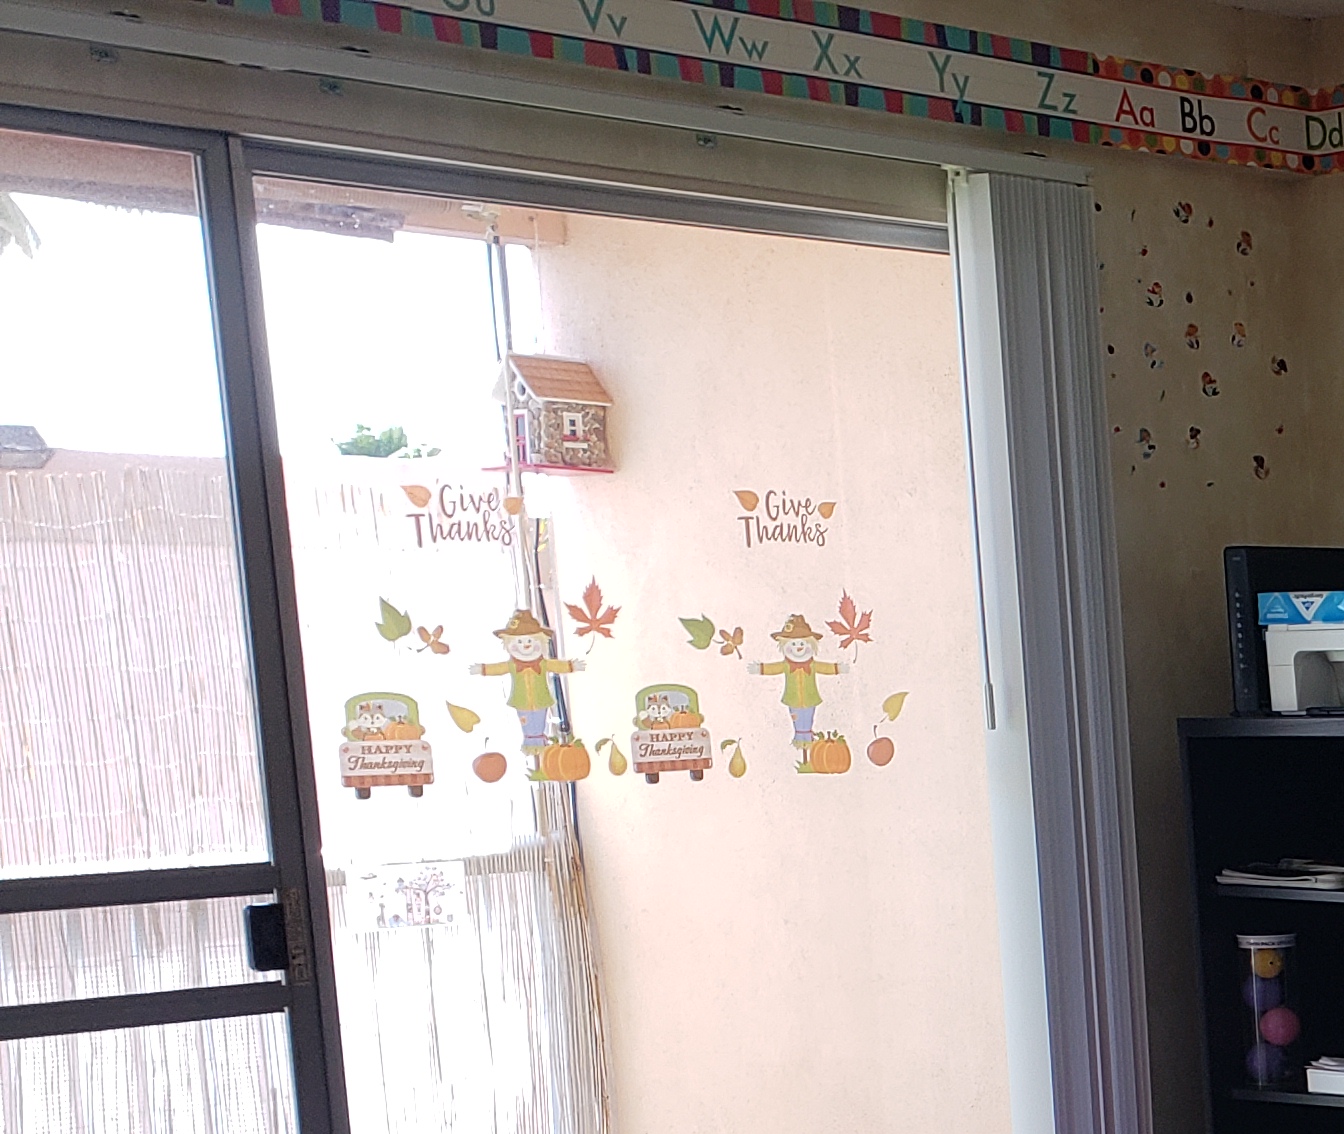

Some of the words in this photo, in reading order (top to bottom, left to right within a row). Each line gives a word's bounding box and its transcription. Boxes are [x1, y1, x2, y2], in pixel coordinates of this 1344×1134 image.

[578, 0, 627, 37] Vv
[692, 9, 768, 60] Ww
[812, 30, 873, 78] Xx
[928, 51, 969, 113] Yy
[1037, 72, 1077, 114] Zz
[1115, 88, 1155, 127] Aa
[1180, 96, 1216, 137] Bb
[1247, 107, 1280, 145] Cc
[1306, 112, 1344, 150] Dd
[434, 483, 500, 519] Give
[764, 489, 816, 521] Give
[406, 513, 515, 548] Thanks
[737, 512, 828, 549] Thanks
[361, 744, 413, 755] HAPPY
[639, 743, 704, 759] Thanksgiving
[649, 731, 694, 743] HAPPY
[348, 754, 425, 774] Thanksgiving
